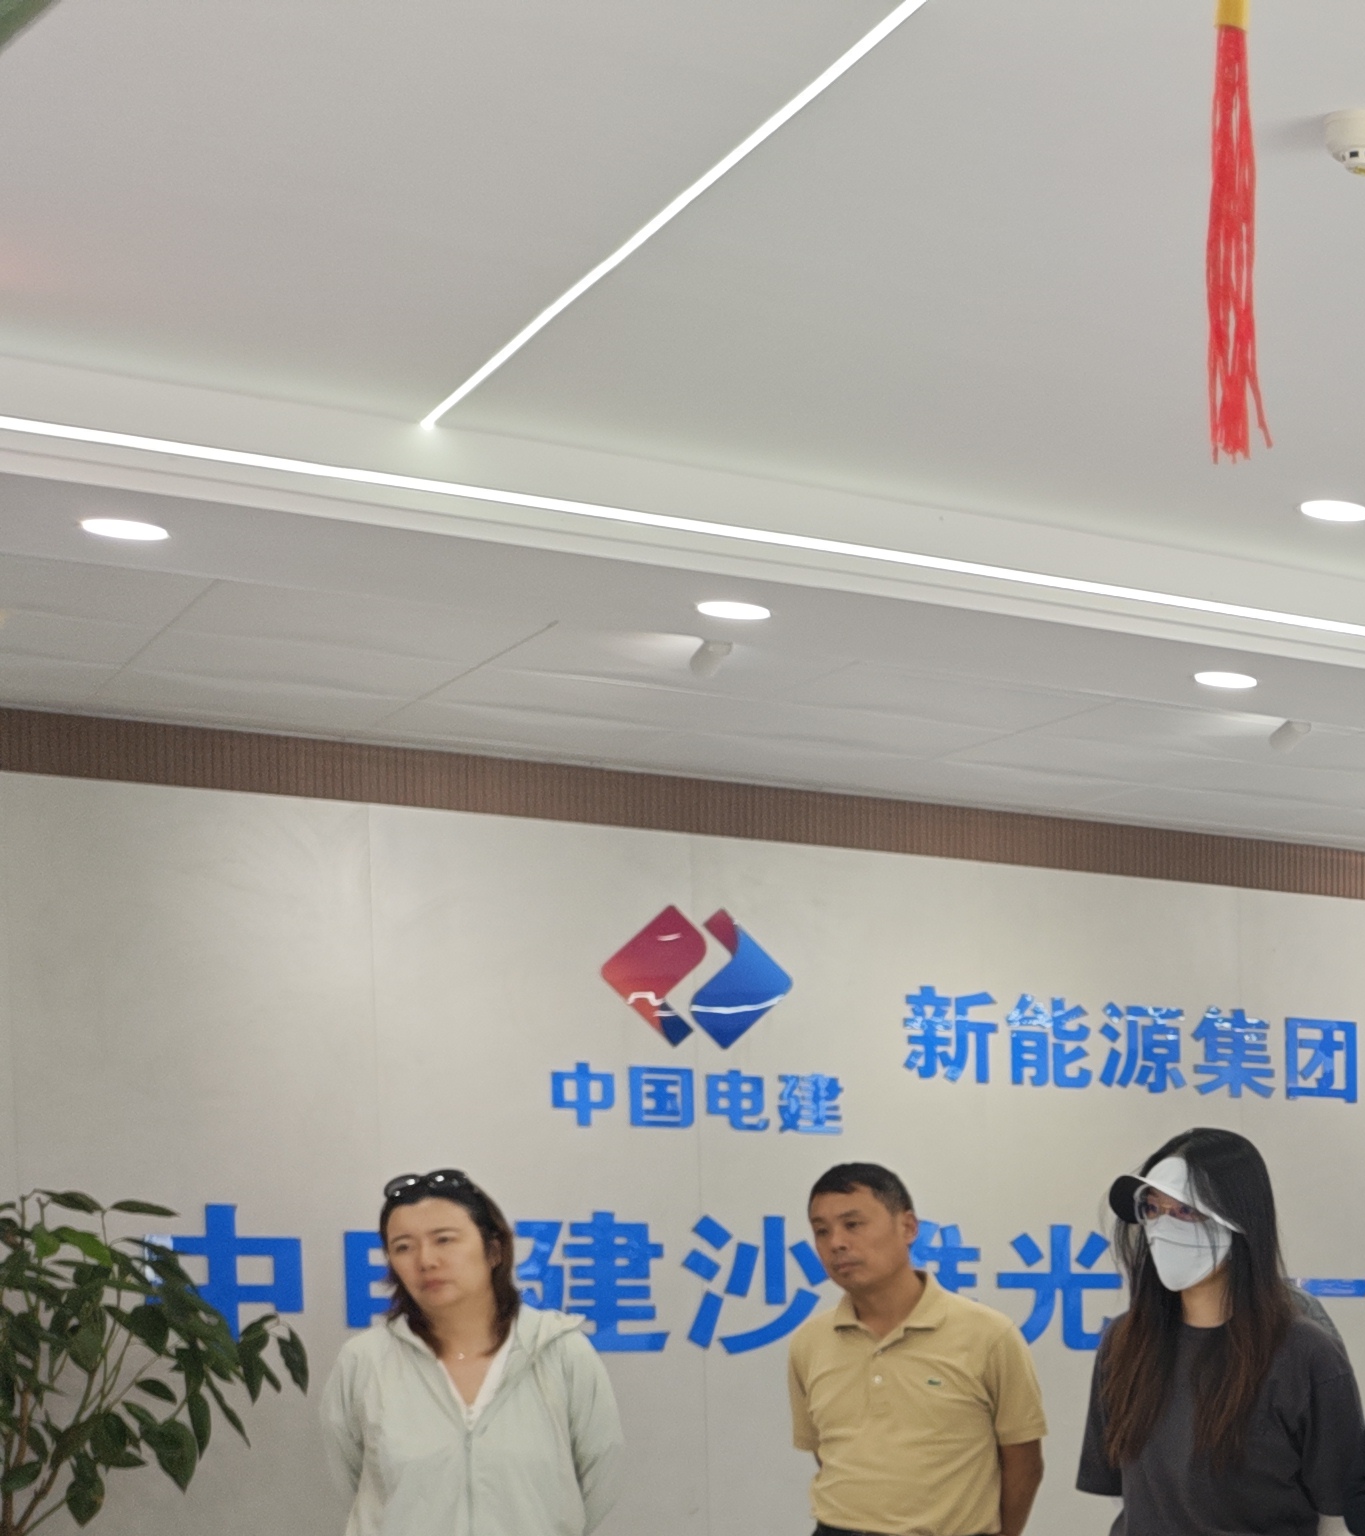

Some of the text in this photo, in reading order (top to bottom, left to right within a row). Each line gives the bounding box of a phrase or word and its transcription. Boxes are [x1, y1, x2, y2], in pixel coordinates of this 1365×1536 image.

[902, 985, 1358, 1104] 新能源集团
[550, 1061, 844, 1135] 中国电建
